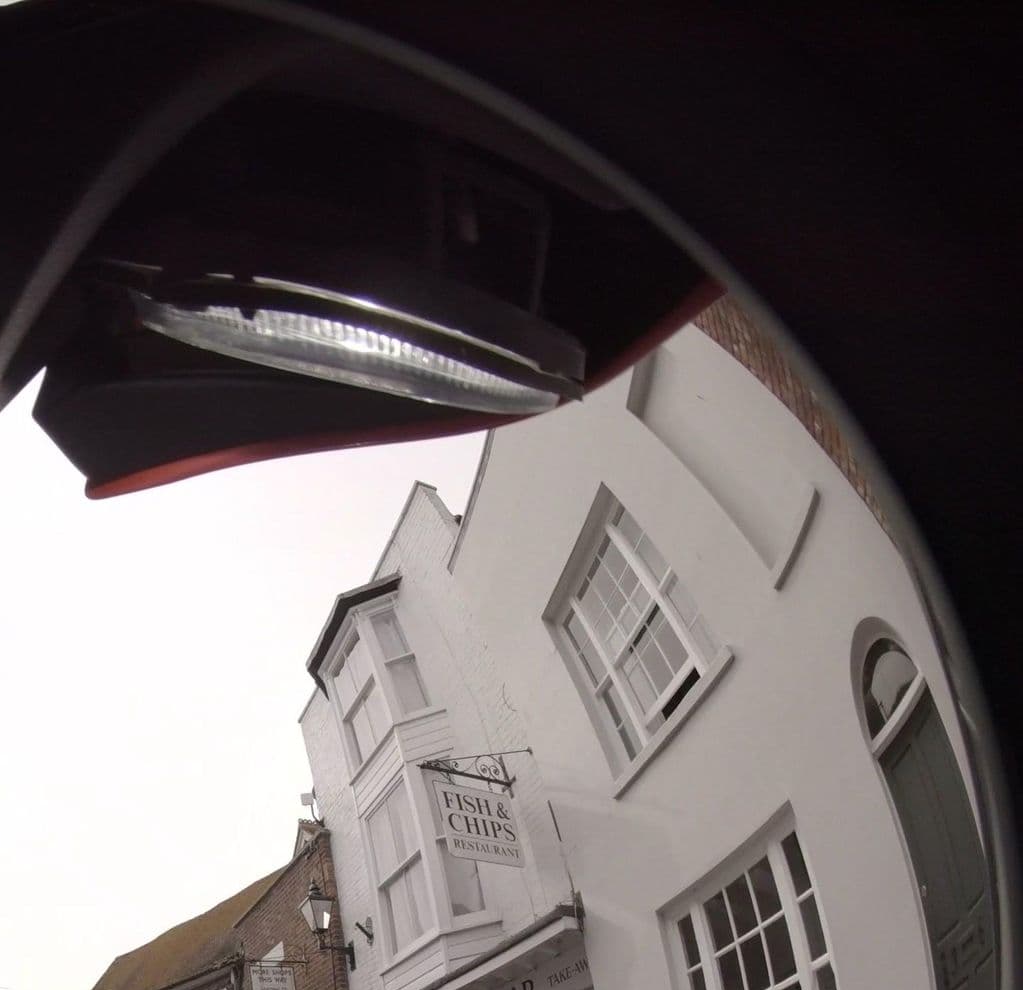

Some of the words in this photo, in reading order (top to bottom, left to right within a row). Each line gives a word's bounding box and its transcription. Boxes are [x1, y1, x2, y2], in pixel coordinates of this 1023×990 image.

[442, 791, 493, 817] FISH
[496, 802, 511, 820] &
[448, 812, 517, 842] CHIPS
[452, 838, 521, 859] RESTAURANT
